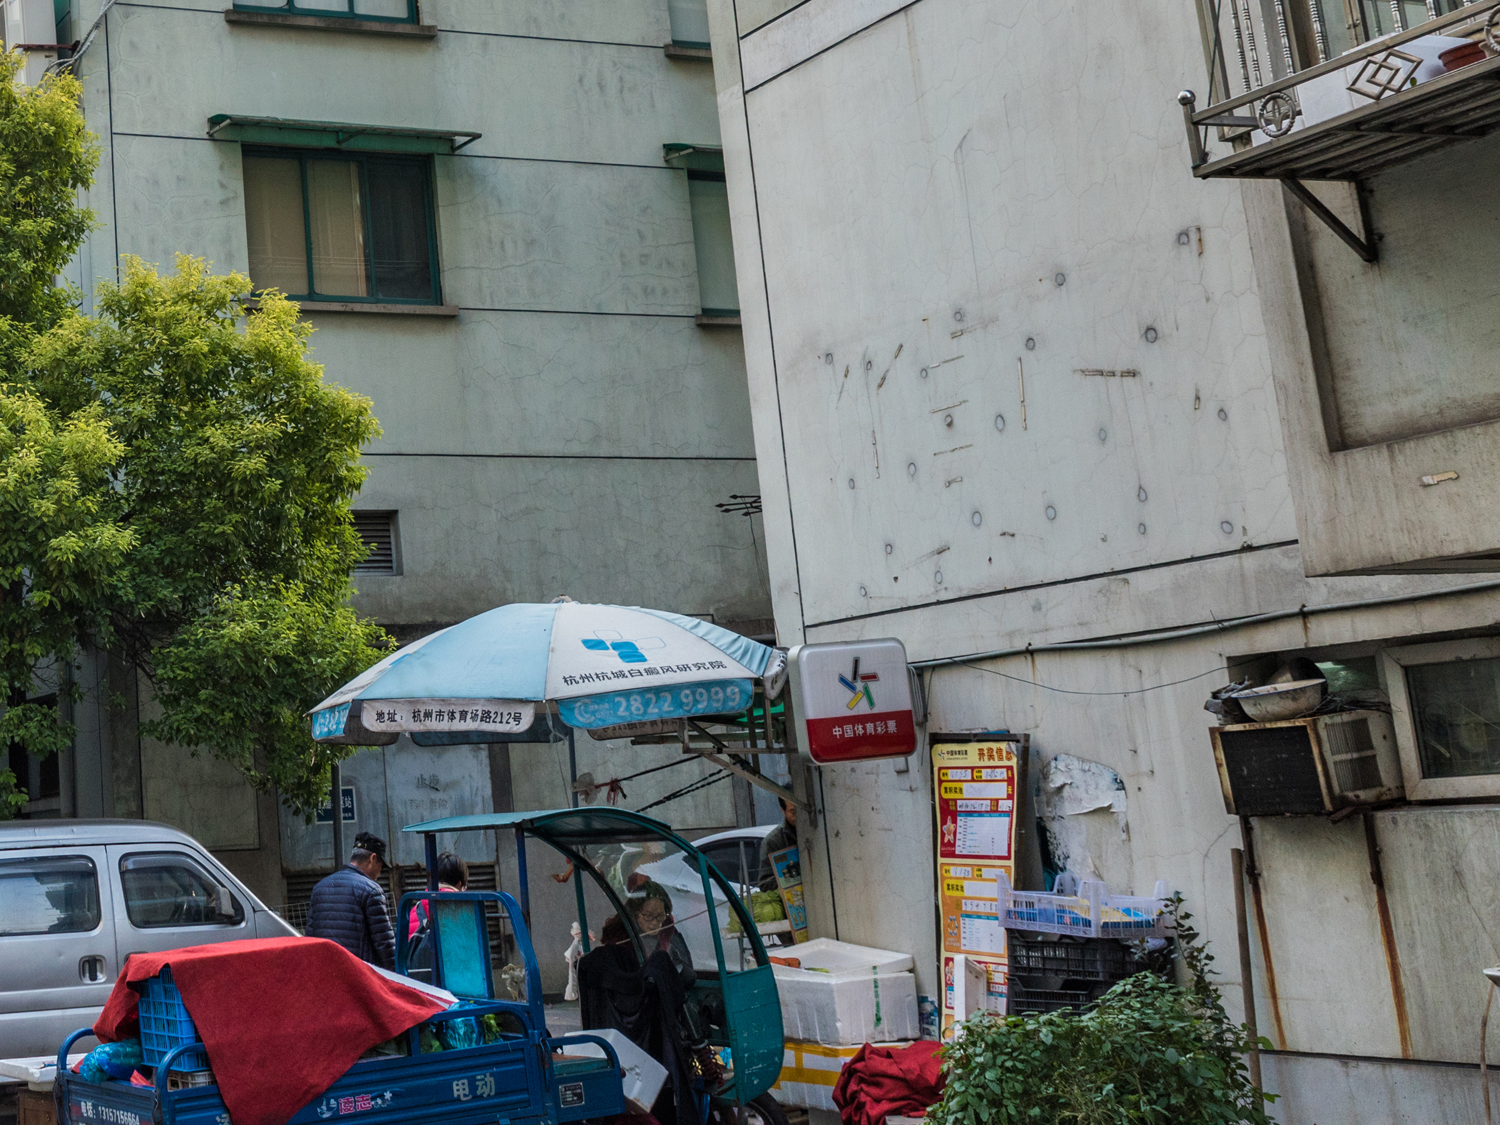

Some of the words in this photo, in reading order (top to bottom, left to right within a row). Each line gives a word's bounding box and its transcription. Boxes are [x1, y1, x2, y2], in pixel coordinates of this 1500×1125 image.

[614, 692, 674, 716] 2822
[680, 686, 740, 711] 9999
[832, 720, 898, 739] 中国体育彩票
[452, 1072, 496, 1102] 电动
[338, 1094, 372, 1115] 凌志
